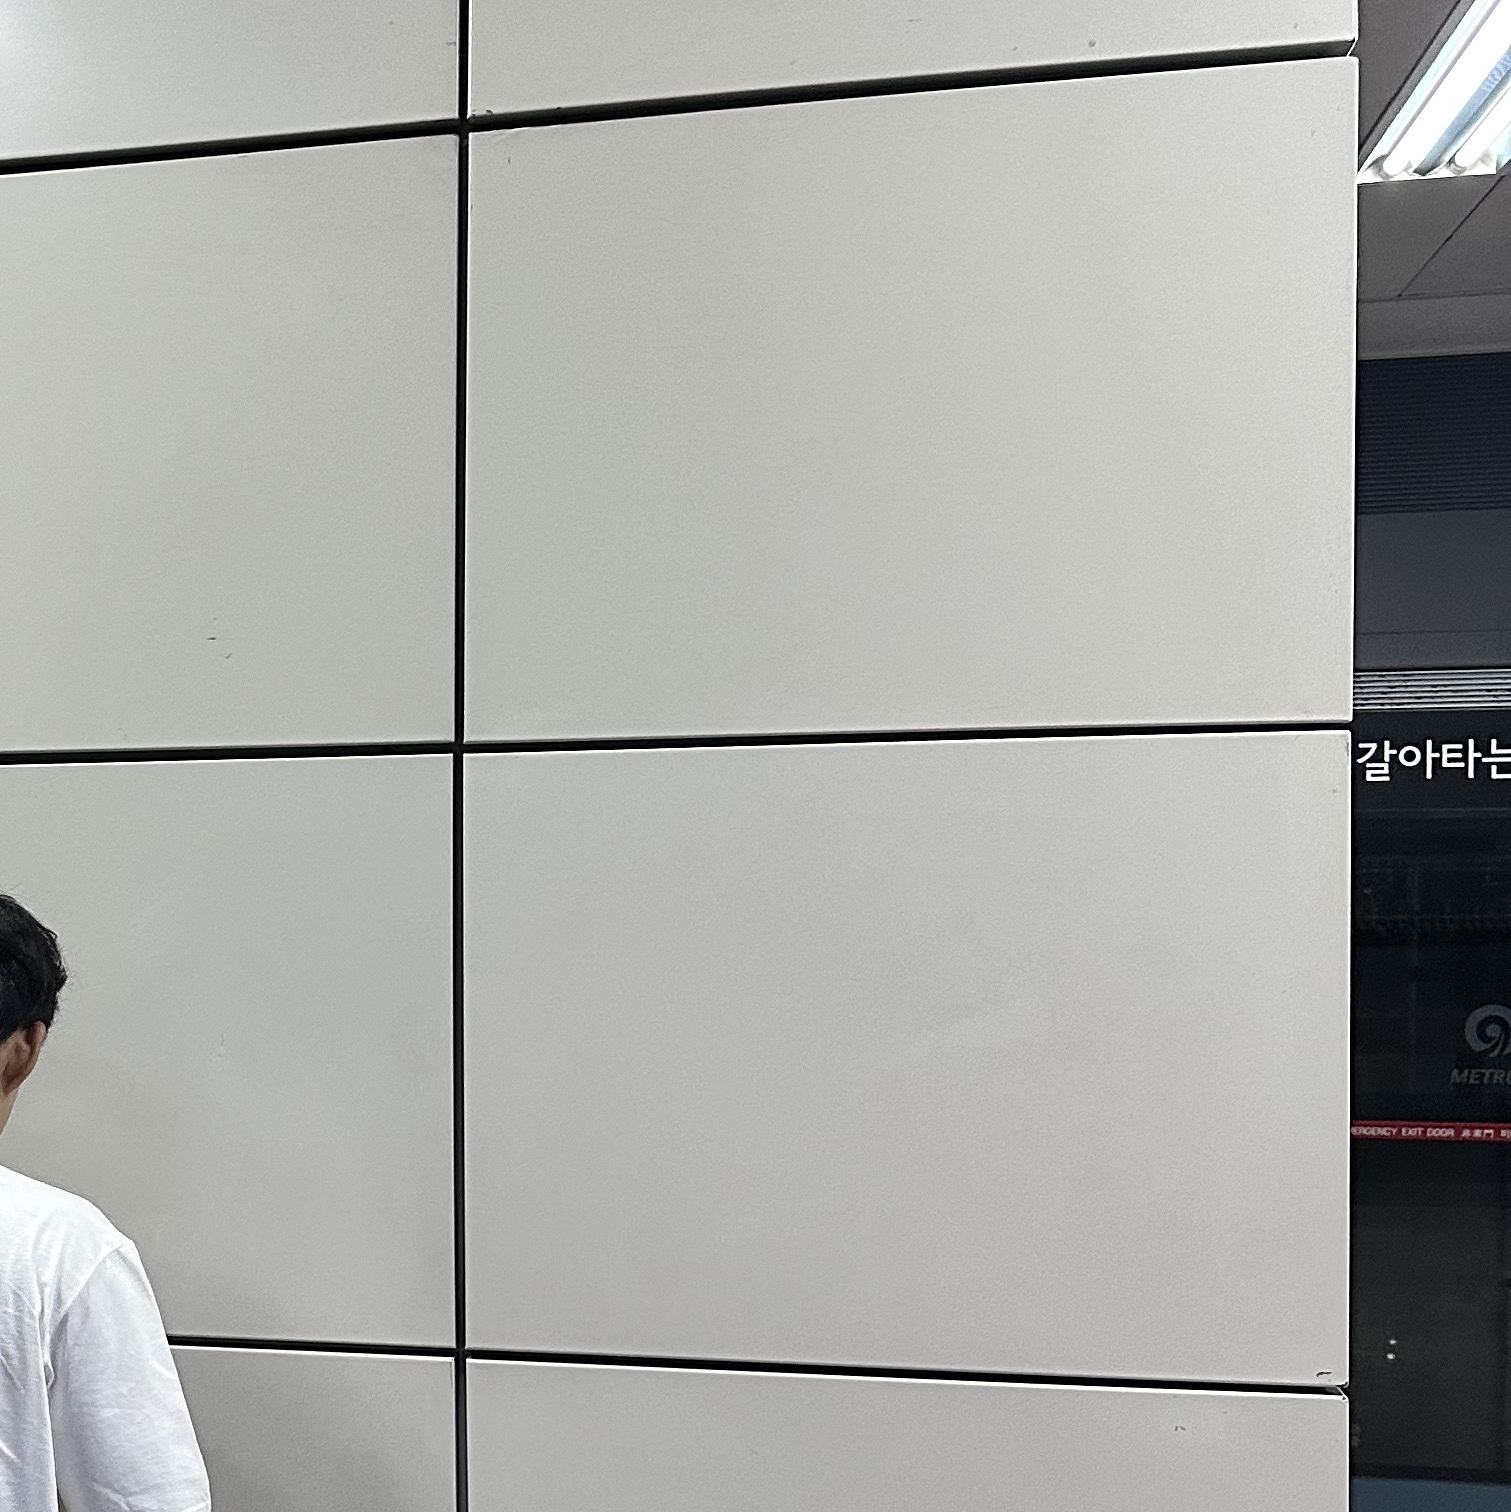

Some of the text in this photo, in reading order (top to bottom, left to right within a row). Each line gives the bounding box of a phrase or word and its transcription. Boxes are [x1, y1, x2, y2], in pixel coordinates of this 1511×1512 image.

[1356, 738, 1511, 782] 갈아타는
[1401, 1127, 1424, 1137] EXIT
[1426, 1127, 1455, 1137] DOOR
